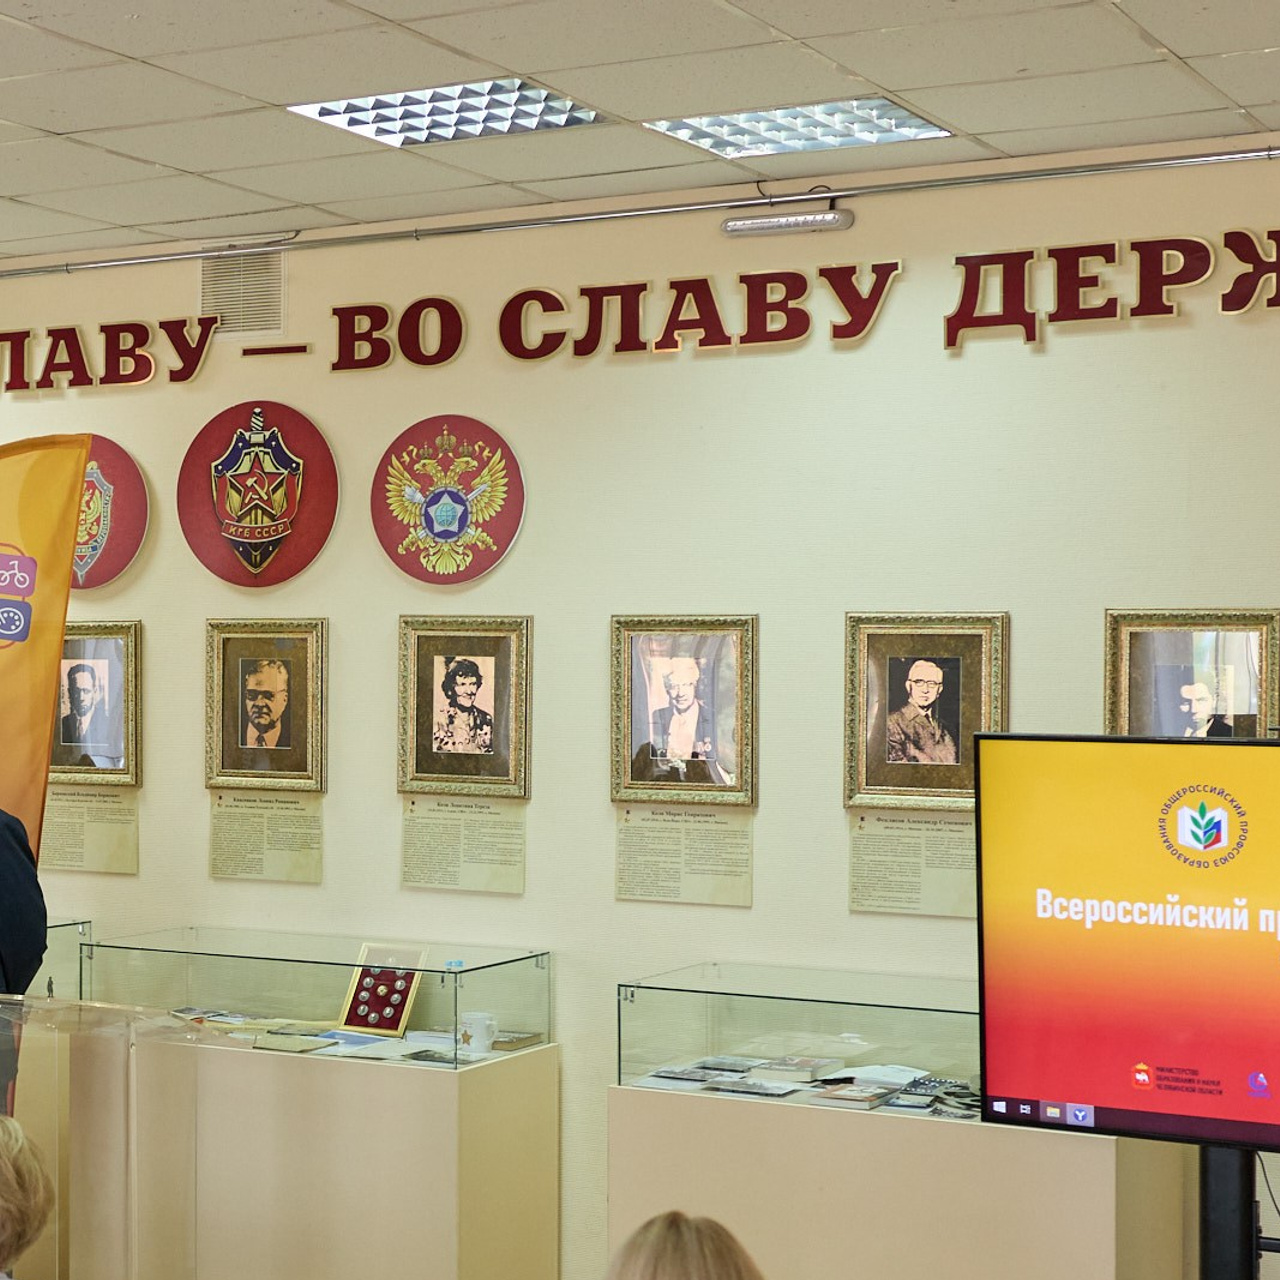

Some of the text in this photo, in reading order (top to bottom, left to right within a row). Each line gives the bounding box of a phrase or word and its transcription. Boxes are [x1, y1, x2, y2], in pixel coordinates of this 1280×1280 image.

[331, 296, 465, 371] ВО
[497, 260, 904, 360] СЛАВУ
[229, 525, 284, 538] КГБ СССР
[1161, 784, 1246, 818] ОБЩЕРОССИЙСКИЙ
[1157, 818, 1210, 868] ОБРАЗОВАНИЯ
[1213, 820, 1248, 867] ПРОФСОЮЗ
[1036, 888, 1280, 941] Всероссийский п
